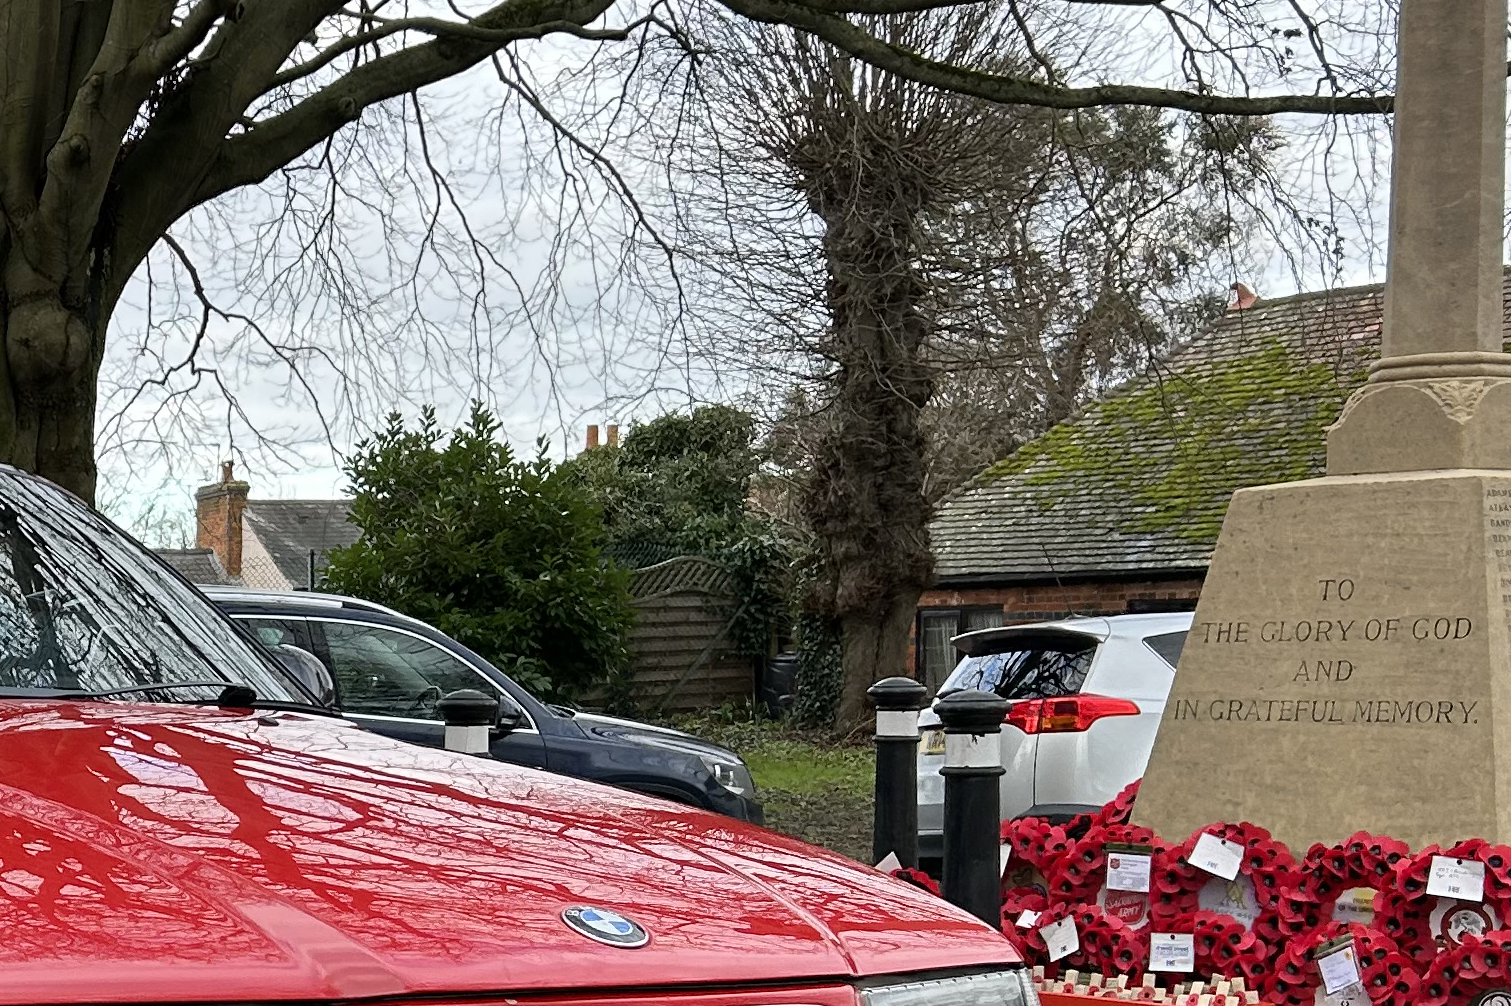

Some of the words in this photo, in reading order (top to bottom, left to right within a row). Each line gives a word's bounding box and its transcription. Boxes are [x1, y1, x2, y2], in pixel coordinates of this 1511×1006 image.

[1318, 578, 1355, 602] TO
[1201, 621, 1249, 644] THE
[1260, 619, 1356, 643] GLORY
[1364, 618, 1401, 642] OF
[1411, 617, 1472, 641] GOD
[1292, 659, 1353, 682] AND
[1173, 699, 1201, 721] IN
[1209, 699, 1344, 723] GRATEFUL
[1351, 700, 1478, 724] MEMORY.
